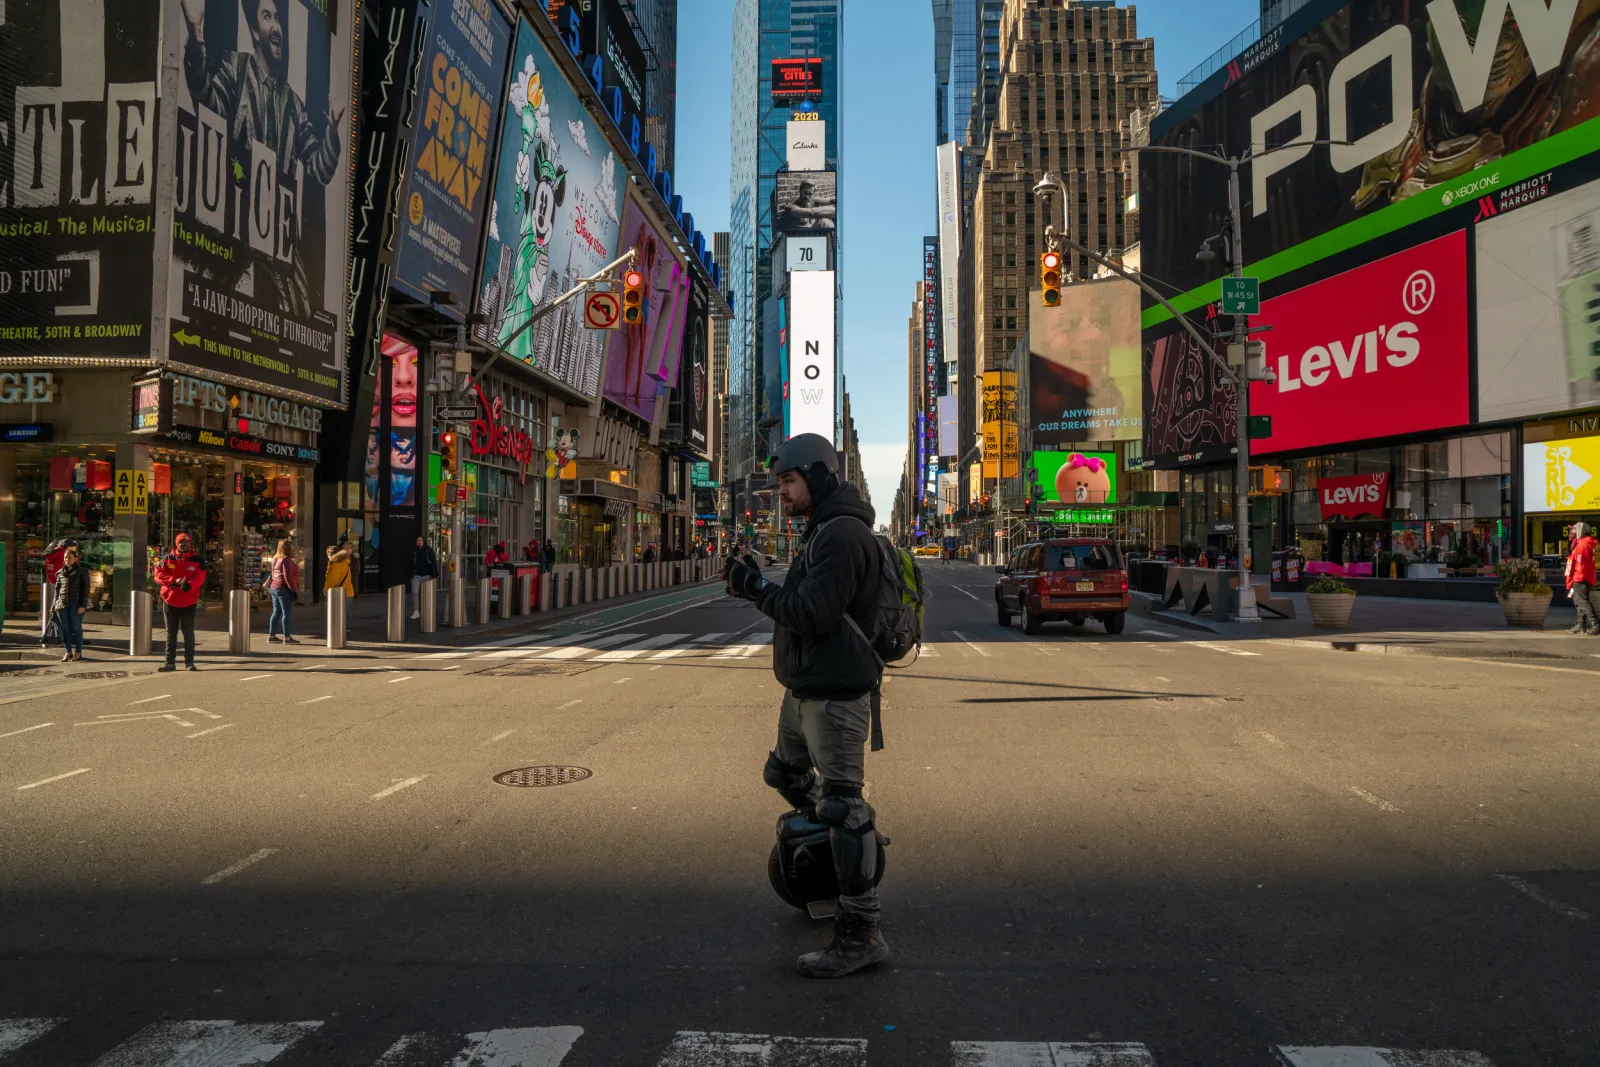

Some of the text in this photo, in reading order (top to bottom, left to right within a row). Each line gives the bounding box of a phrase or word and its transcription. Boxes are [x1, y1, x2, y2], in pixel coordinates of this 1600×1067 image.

[1245, 26, 1283, 60] MARRIOTT
[1245, 41, 1279, 72] MARQUIS
[784, 72, 812, 80] CITIES
[432, 52, 492, 132] COME
[794, 112, 819, 121] 2020
[0, 98, 148, 208] TLE
[793, 141, 818, 149] Clarks
[417, 136, 481, 212] AWAY
[1454, 173, 1500, 200] XBOX ONE
[1500, 172, 1553, 200] MARRIOTT
[174, 122, 295, 263] JUICE
[1501, 186, 1547, 210] MARQUIS
[574, 185, 608, 235] WELCOME
[57, 217, 87, 236] The
[93, 215, 155, 234] Musical.
[174, 223, 192, 246] The
[799, 247, 813, 262] 70
[1227, 291, 1254, 299] W 45 St
[203, 288, 280, 335] JAW-DROPPING
[46, 326, 71, 338] 50TH
[74, 326, 82, 337] &
[85, 324, 143, 338] BROADWAY
[204, 338, 217, 354] THIS
[219, 344, 231, 358] WAY
[233, 347, 241, 360] TO
[242, 350, 252, 364] THE
[253, 354, 289, 375] NETHERWORLD
[164, 374, 226, 412] IFTS
[241, 389, 322, 433] LUGGAGE
[1062, 407, 1117, 419] ANYWHERE
[1038, 422, 1059, 431] OUR
[1061, 421, 1100, 430] DREAMS
[1103, 418, 1127, 427] TAKE
[197, 430, 225, 447] Nikon
[229, 436, 260, 453] Canon
[266, 442, 295, 457] SONY
[118, 472, 129, 508] ATM
[136, 473, 145, 508] ATM
